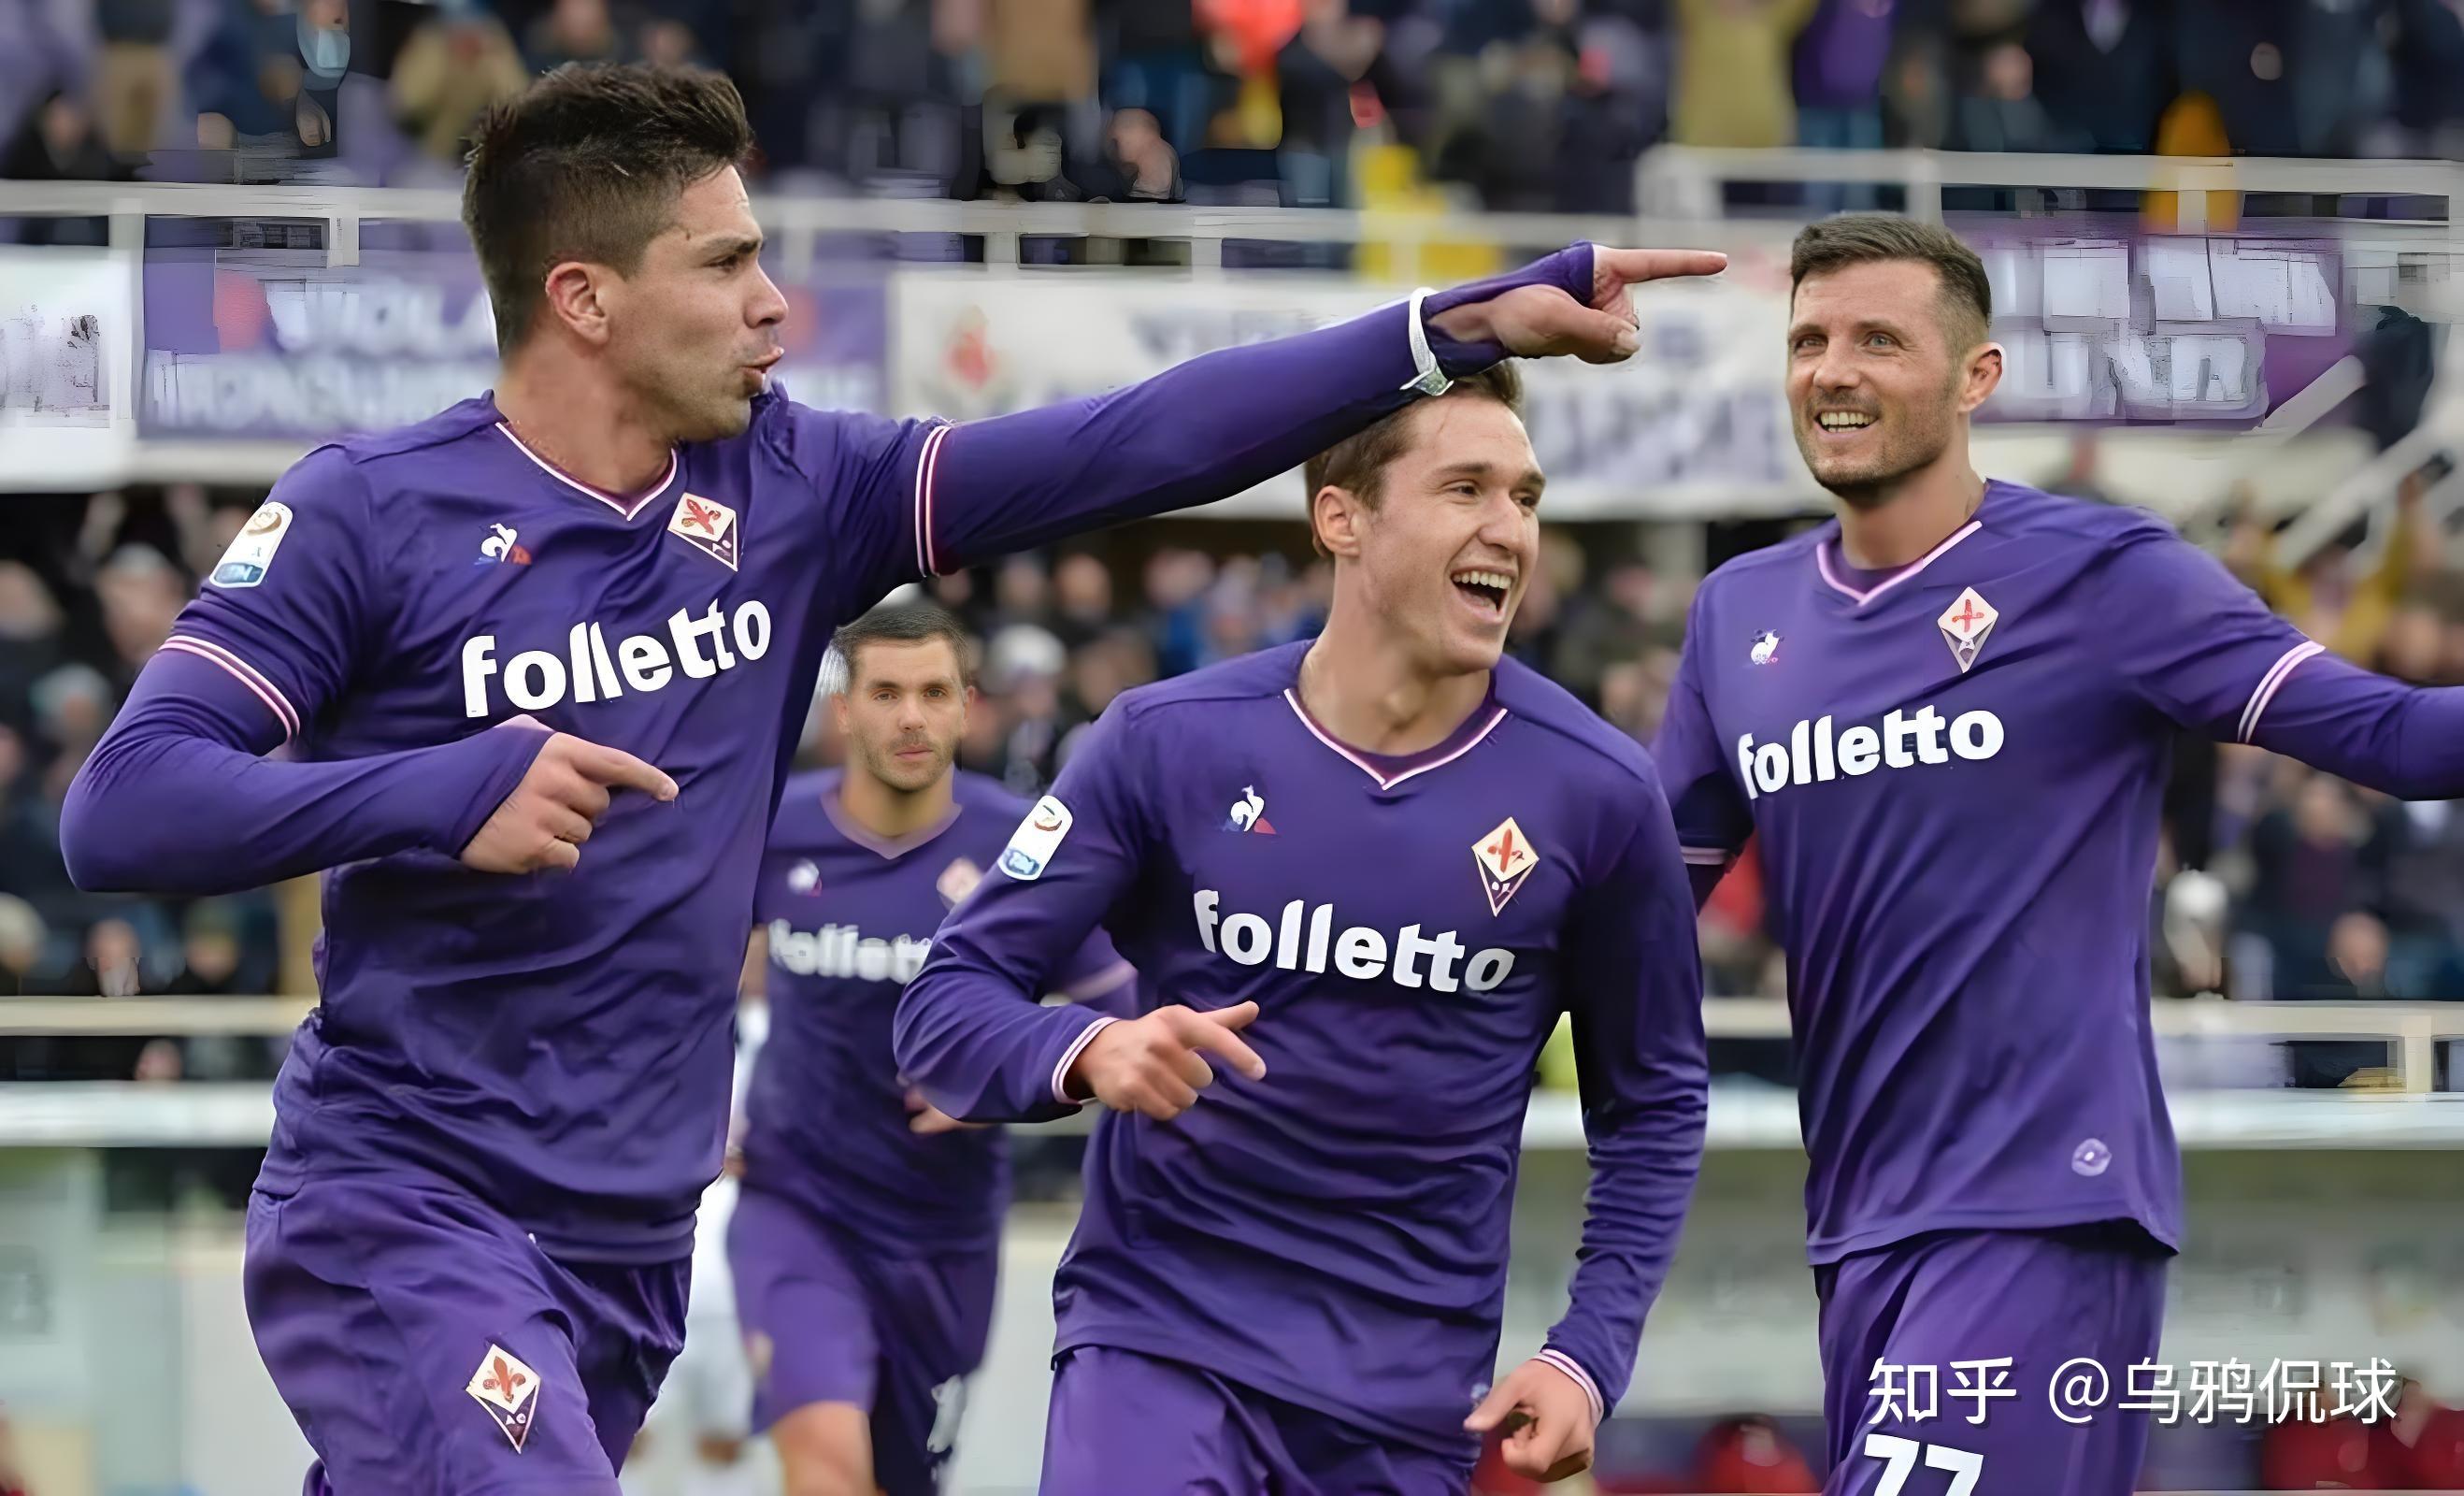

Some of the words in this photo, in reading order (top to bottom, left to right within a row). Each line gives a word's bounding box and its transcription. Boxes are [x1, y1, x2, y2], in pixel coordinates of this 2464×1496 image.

[461, 597, 772, 718] folletto
[1737, 703, 2005, 800] folletto
[768, 918, 934, 985] follet
[1193, 888, 1516, 993] folletto
[1864, 1433, 1984, 1496] 77
